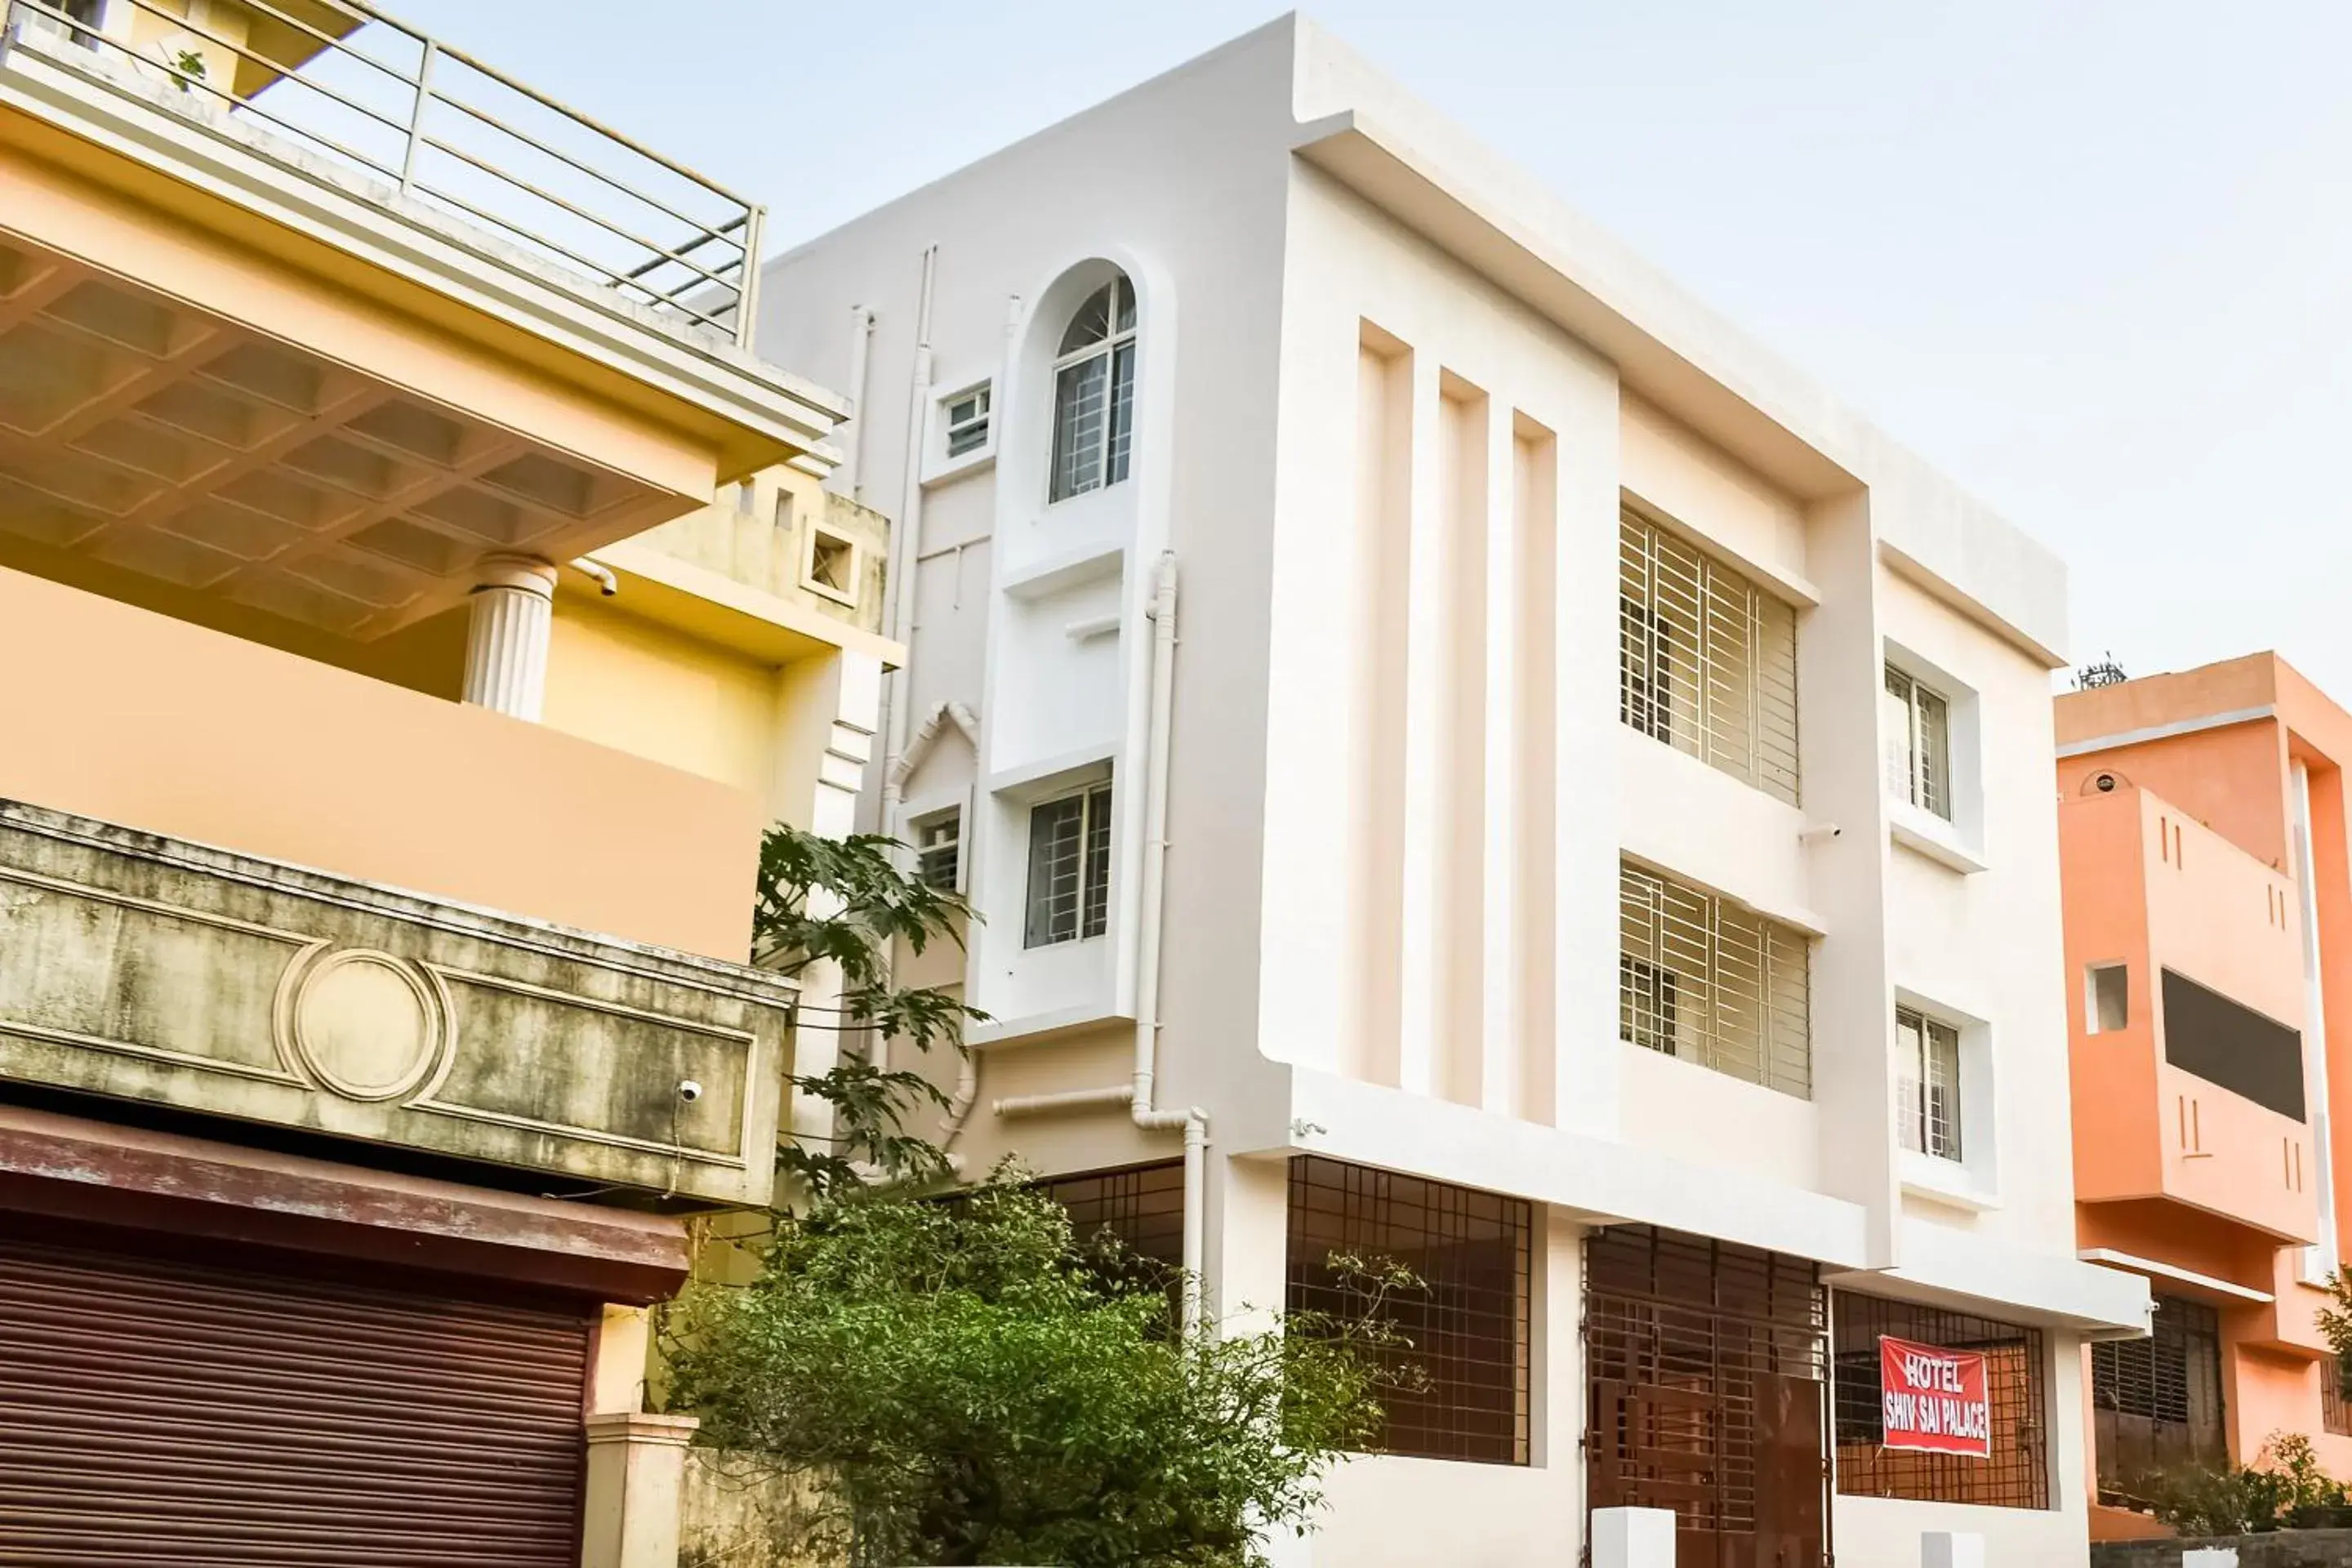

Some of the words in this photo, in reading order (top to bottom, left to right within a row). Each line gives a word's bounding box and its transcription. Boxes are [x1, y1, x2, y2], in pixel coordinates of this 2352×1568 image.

[1905, 1354, 1963, 1392] HOTEL
[1886, 1391, 1916, 1430] SHIV
[1920, 1395, 1940, 1433] SAI
[1942, 1399, 1985, 1439] PALACE
